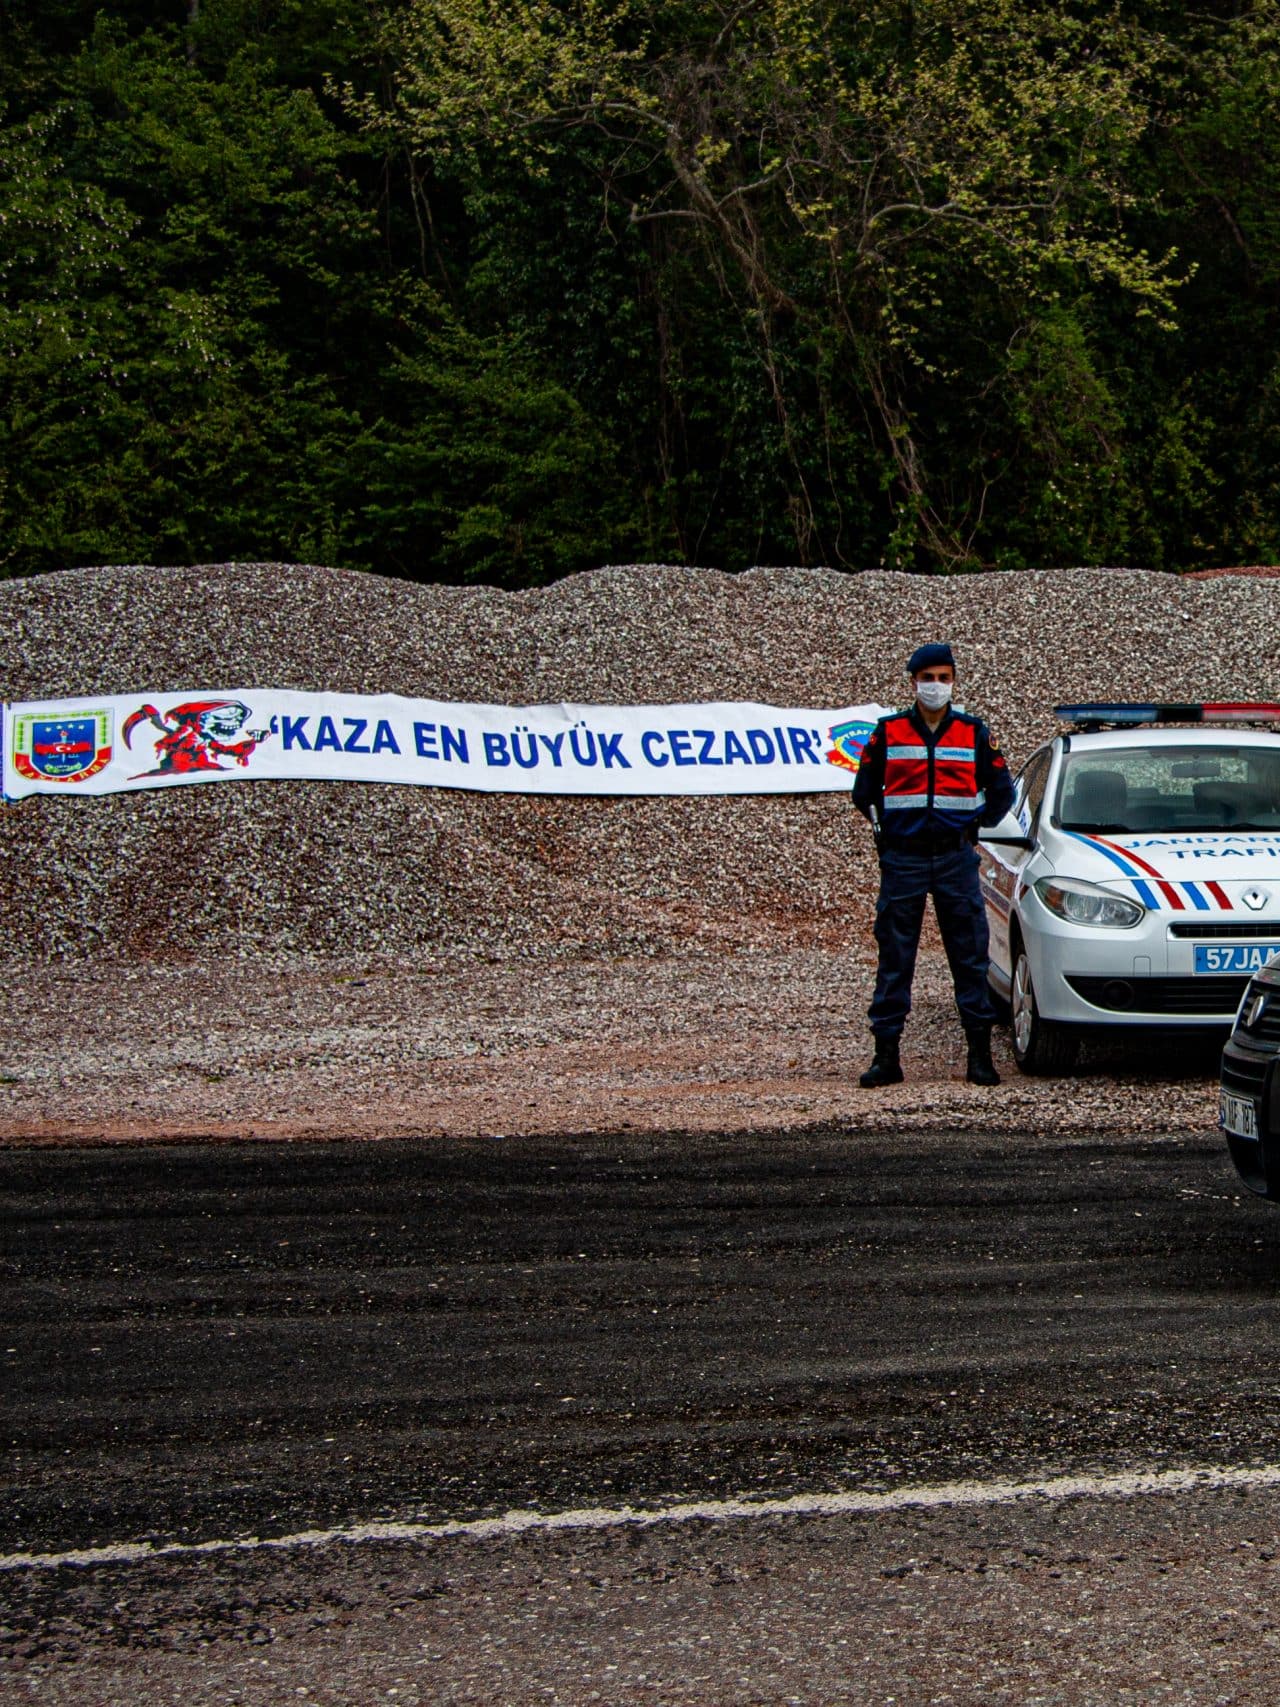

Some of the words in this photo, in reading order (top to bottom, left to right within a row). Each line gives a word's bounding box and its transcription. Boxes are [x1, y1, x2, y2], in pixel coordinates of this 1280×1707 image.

[270, 715, 402, 754] ‘KAZA
[413, 722, 470, 764] EN
[482, 720, 633, 769] BÜYÜK
[641, 726, 822, 767] CEZADIR’
